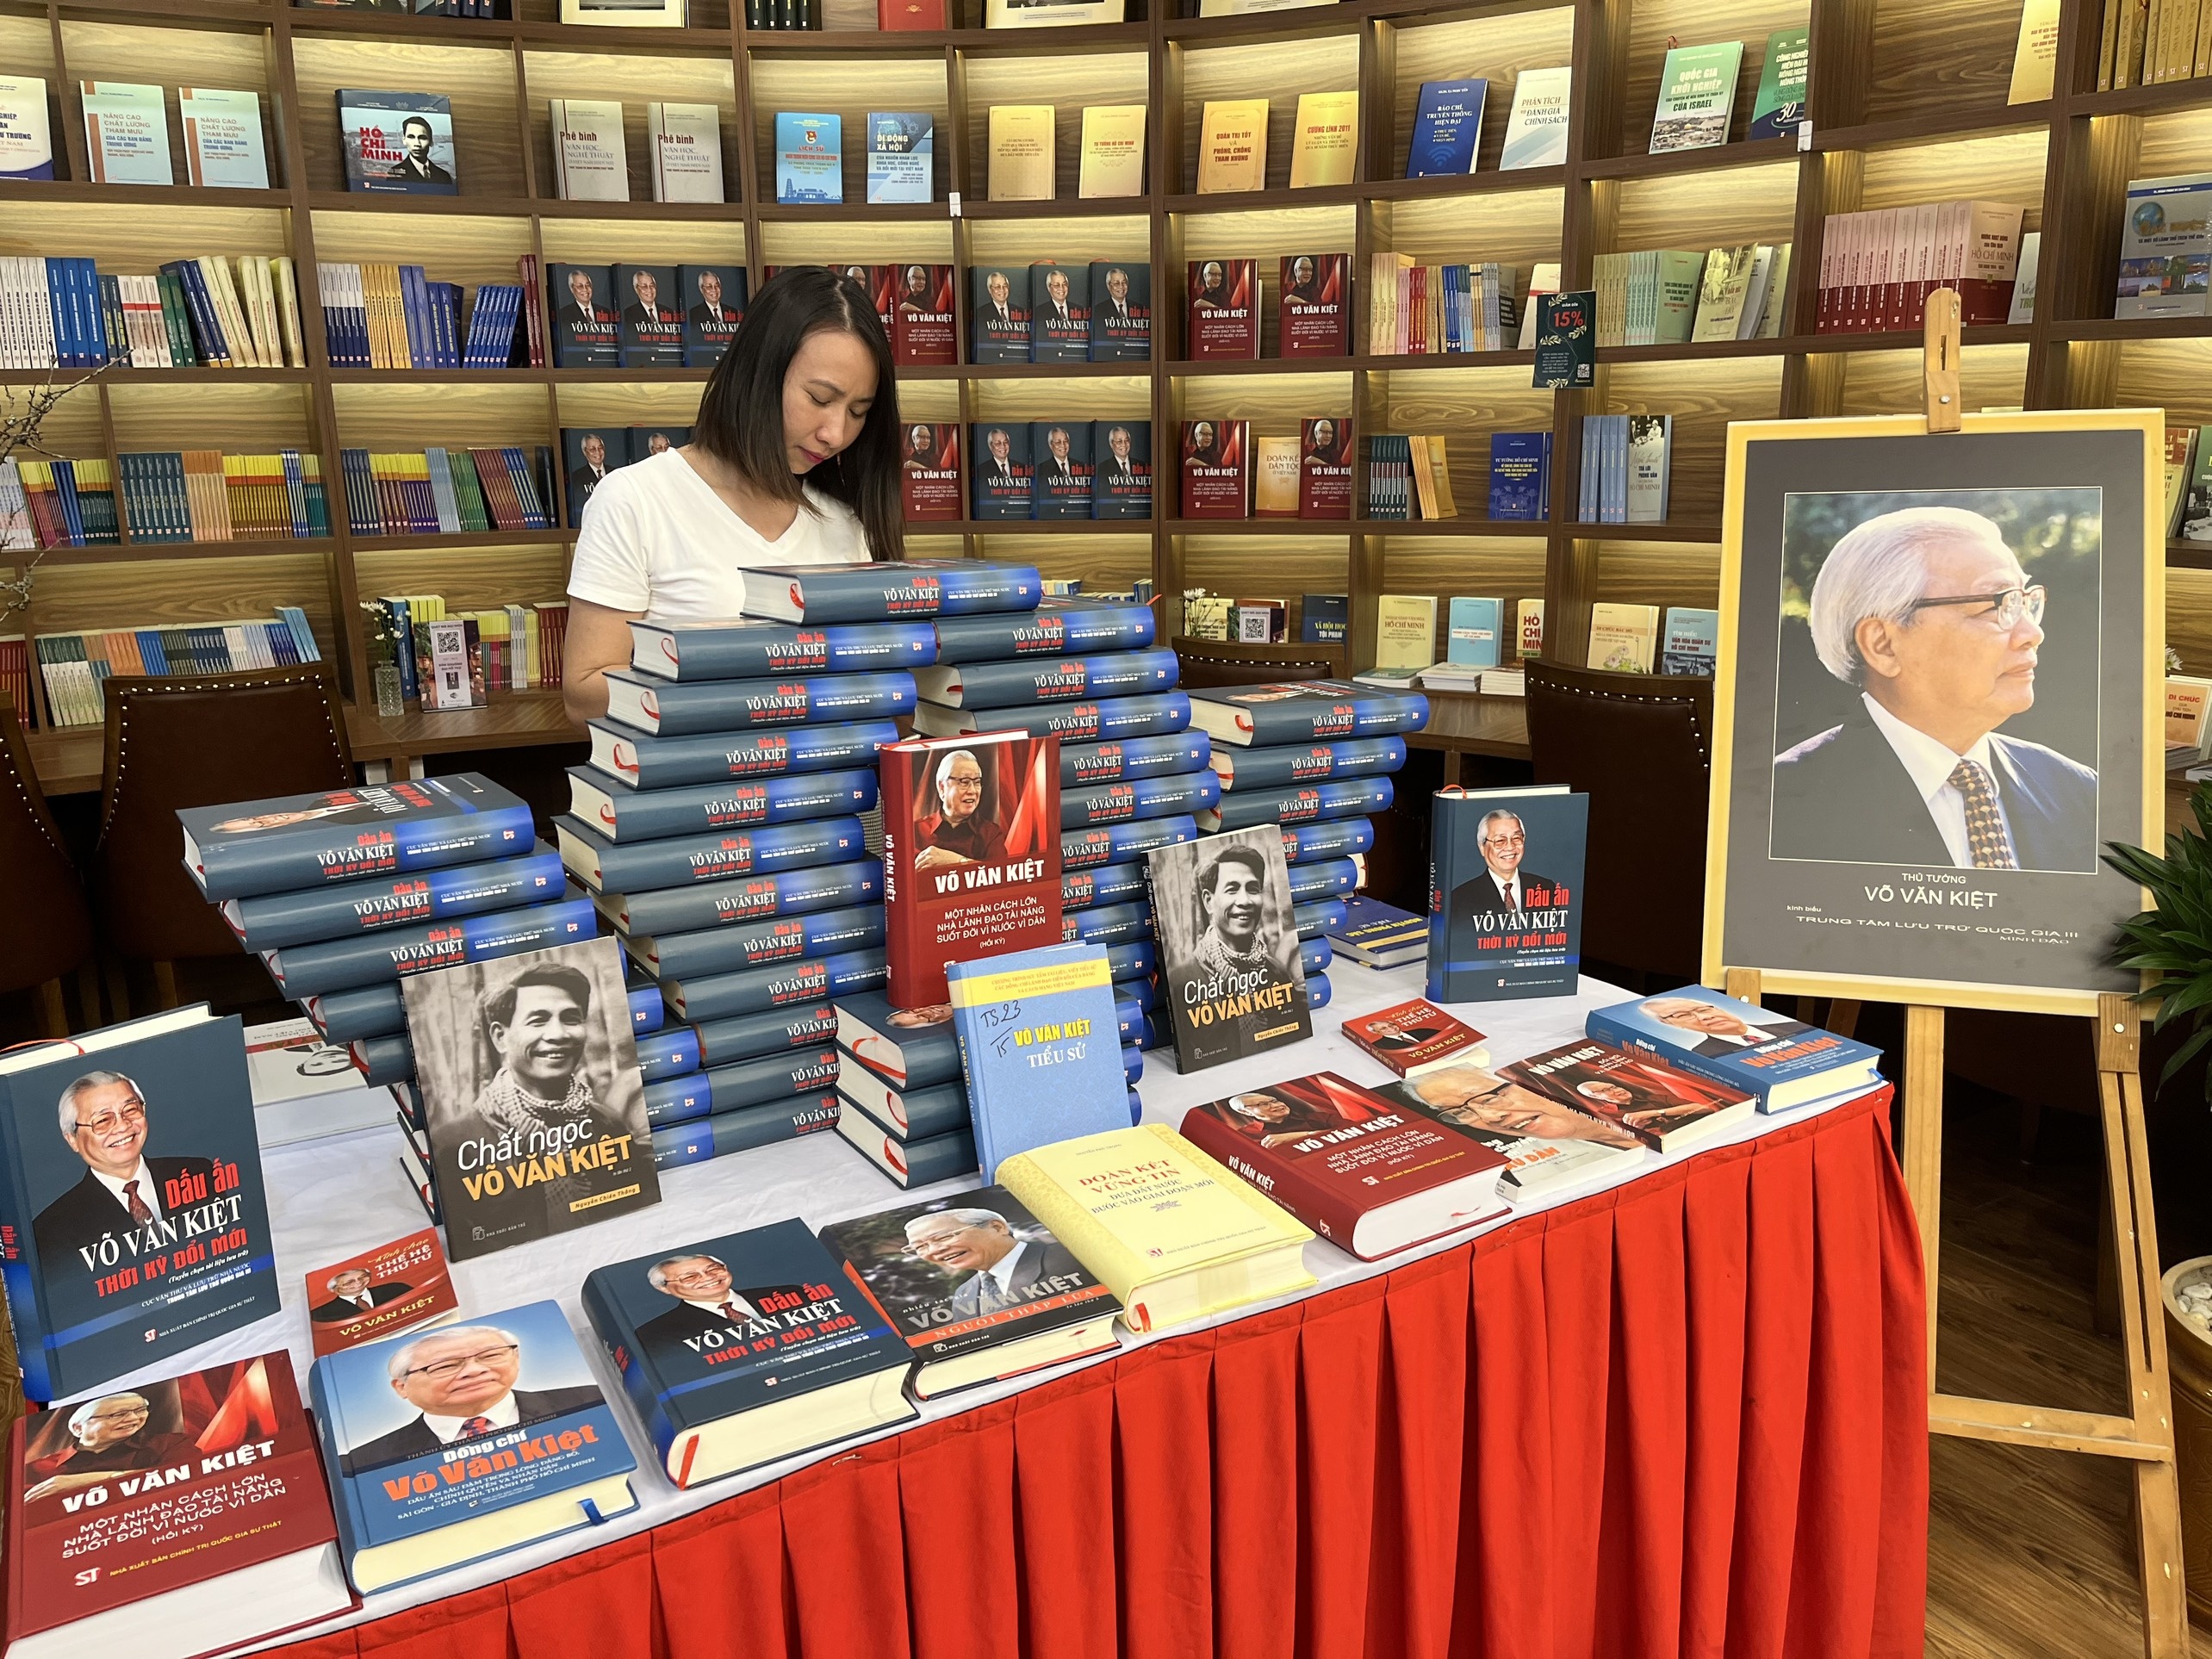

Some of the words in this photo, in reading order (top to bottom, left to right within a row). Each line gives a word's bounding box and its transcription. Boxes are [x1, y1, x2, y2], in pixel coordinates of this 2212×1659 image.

[1703, 67, 1718, 78] GIA
[1692, 78, 1723, 94] NGHIỆP
[1426, 110, 1451, 119] TRUYỀN
[1451, 109, 1473, 118] THÔNG
[1438, 103, 1451, 112] BÁO
[1522, 97, 1543, 107] PHÂN
[1544, 96, 1561, 105] TÍCH
[1526, 109, 1547, 117] ĐÁNH
[1548, 106, 1561, 115] GIÁ
[1673, 101, 1688, 112] CỦA
[1689, 98, 1712, 110] ISRAEL
[1776, 101, 1797, 122] 30
[103, 113, 124, 121] NÂNG
[1525, 117, 1547, 127] CHÍNH
[1548, 115, 1568, 125] SÁCH
[560, 131, 576, 141] Phê
[578, 131, 597, 141] bình
[360, 148, 403, 162] MINH
[1201, 309, 1212, 319] VÕ
[1213, 308, 1229, 319] VĂN
[1230, 308, 1248, 320] KIỆT
[1554, 310, 1584, 328] 15%
[884, 587, 898, 601] VÕ
[898, 587, 917, 601] VĂN
[918, 586, 940, 602] KIỆT
[1523, 612, 1540, 627] HỒ
[316, 848, 339, 867] VÕ
[339, 846, 364, 865] VĂN
[365, 843, 395, 862] KIỆT
[935, 868, 960, 895] VÕ
[964, 865, 1002, 890] VĂN
[1006, 858, 1046, 883] KIỆT
[1902, 873, 1923, 883] THỦ
[1926, 873, 1967, 885] TƯỚNG
[1525, 883, 1550, 908] Dấu
[1553, 882, 1570, 905] ấn
[1864, 884, 1894, 903] VÕ
[1900, 887, 1942, 905] VĂN
[1950, 891, 1998, 910] KIỆT
[937, 921, 957, 933] NHÀ
[958, 916, 983, 929] LÃNH
[984, 913, 1003, 926] ĐẠO
[1004, 910, 1019, 921] TÀI
[1020, 905, 1045, 919] NĂNG
[945, 909, 965, 921] MỘT
[966, 904, 991, 919] NHÂN
[993, 898, 1018, 914] CÁCH
[1020, 896, 1038, 909] LỚN
[1473, 910, 1494, 933] VÕ
[1498, 908, 1530, 931] VĂN
[1532, 908, 1569, 933] KIỆT
[936, 927, 961, 944] SUỐT
[962, 925, 979, 939] ĐỜI
[980, 924, 990, 936] VÌ
[991, 921, 1016, 935] NƯỚC
[1017, 918, 1027, 929] VÌ
[1028, 915, 1046, 929] DÂN
[1796, 916, 1852, 925] TRUNG
[1856, 918, 1891, 928] TÂM
[1895, 921, 1930, 930] LƯU
[1934, 923, 1971, 932] TRỮ
[2031, 929, 2060, 938] GIA
[2065, 930, 2078, 939] III
[1184, 972, 1225, 1004] Chất
[1227, 968, 1268, 997] ngọc
[1187, 1000, 1214, 1028] VÕ
[1214, 992, 1252, 1022] VĂN
[1253, 981, 1294, 1011] KIỆT
[1014, 1028, 1034, 1047] VÕ
[1035, 1023, 1061, 1044] VĂN
[1063, 1018, 1091, 1039] KIỆT
[1408, 1049, 1423, 1059] VÕ
[1423, 1041, 1445, 1055] VĂN
[1444, 1032, 1466, 1047] KIỆT
[1027, 1045, 1065, 1068] TIỂU
[1066, 1041, 1087, 1061] SỬ
[457, 1126, 524, 1171] Chất
[529, 1119, 593, 1157] ngọc
[1293, 1136, 1325, 1154] VÕ
[1326, 1126, 1365, 1145] VĂN
[1365, 1113, 1407, 1132] KIỆT
[462, 1164, 505, 1202] VÕ
[506, 1152, 568, 1190] VĂN
[569, 1134, 633, 1174] KIỆT
[1078, 1167, 1133, 1187] ĐOÀN
[1134, 1159, 1171, 1174] KẾT
[1090, 1177, 1146, 1194] VỮNG
[1146, 1167, 1182, 1180] TIN
[165, 1167, 208, 1209] Dấu
[212, 1158, 240, 1194] ấn
[78, 1231, 121, 1273] VÕ
[122, 1215, 178, 1258] VĂN
[182, 1194, 243, 1234] KIỆT
[95, 1264, 140, 1297] THỜI
[144, 1254, 169, 1281] KỲ
[172, 1239, 207, 1270] ĐỔI
[210, 1227, 249, 1257] MỚI
[758, 1290, 804, 1314] Dấu
[803, 1282, 836, 1302] ấn
[907, 1305, 954, 1330] VÕ
[954, 1290, 1022, 1317] VĂN
[1025, 1271, 1084, 1299] KIỆT
[682, 1327, 725, 1353] VÕ
[724, 1316, 782, 1341] VĂN
[781, 1297, 844, 1327] KIỆT
[935, 1316, 996, 1339] NGƯỜI
[1004, 1300, 1053, 1319] THÁP
[1060, 1290, 1095, 1304] LỬA
[443, 1441, 495, 1464] Đồng
[496, 1428, 528, 1449] chí
[382, 1469, 438, 1501] Võ
[438, 1448, 519, 1486] Văn
[518, 1423, 600, 1463] Kiệt
[62, 1485, 109, 1514] VÕ
[119, 1464, 192, 1497] VĂN
[201, 1439, 276, 1475] KIỆT
[74, 1567, 103, 1587] ST
